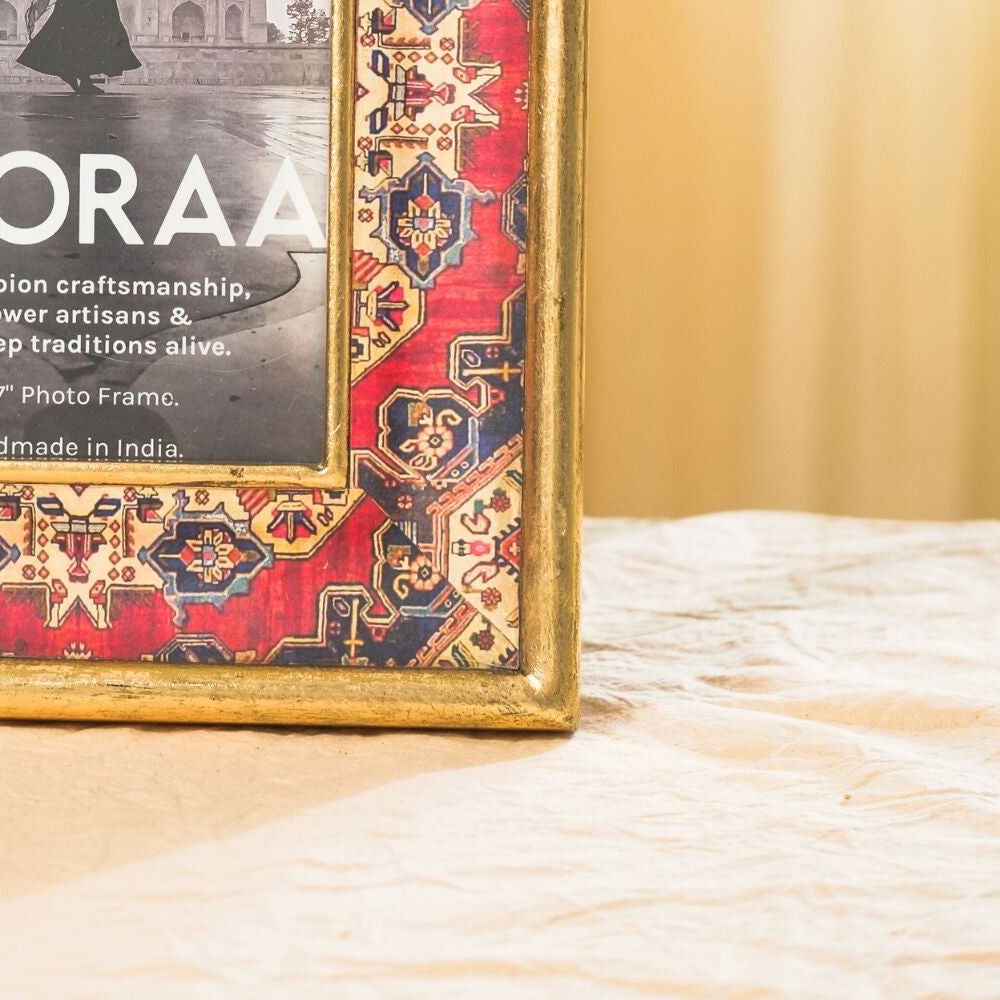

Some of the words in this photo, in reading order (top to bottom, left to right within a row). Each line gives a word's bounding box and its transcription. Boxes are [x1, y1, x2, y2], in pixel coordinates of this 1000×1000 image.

[56, 275, 254, 302] craftsmanship,
[55, 305, 161, 326] artisans
[169, 306, 193, 327] &
[30, 333, 157, 355] traditions
[165, 336, 232, 357] alive.
[22, 385, 90, 405] Photo
[98, 387, 180, 407] Frame.
[87, 437, 109, 457] in
[118, 438, 183, 458] India.
